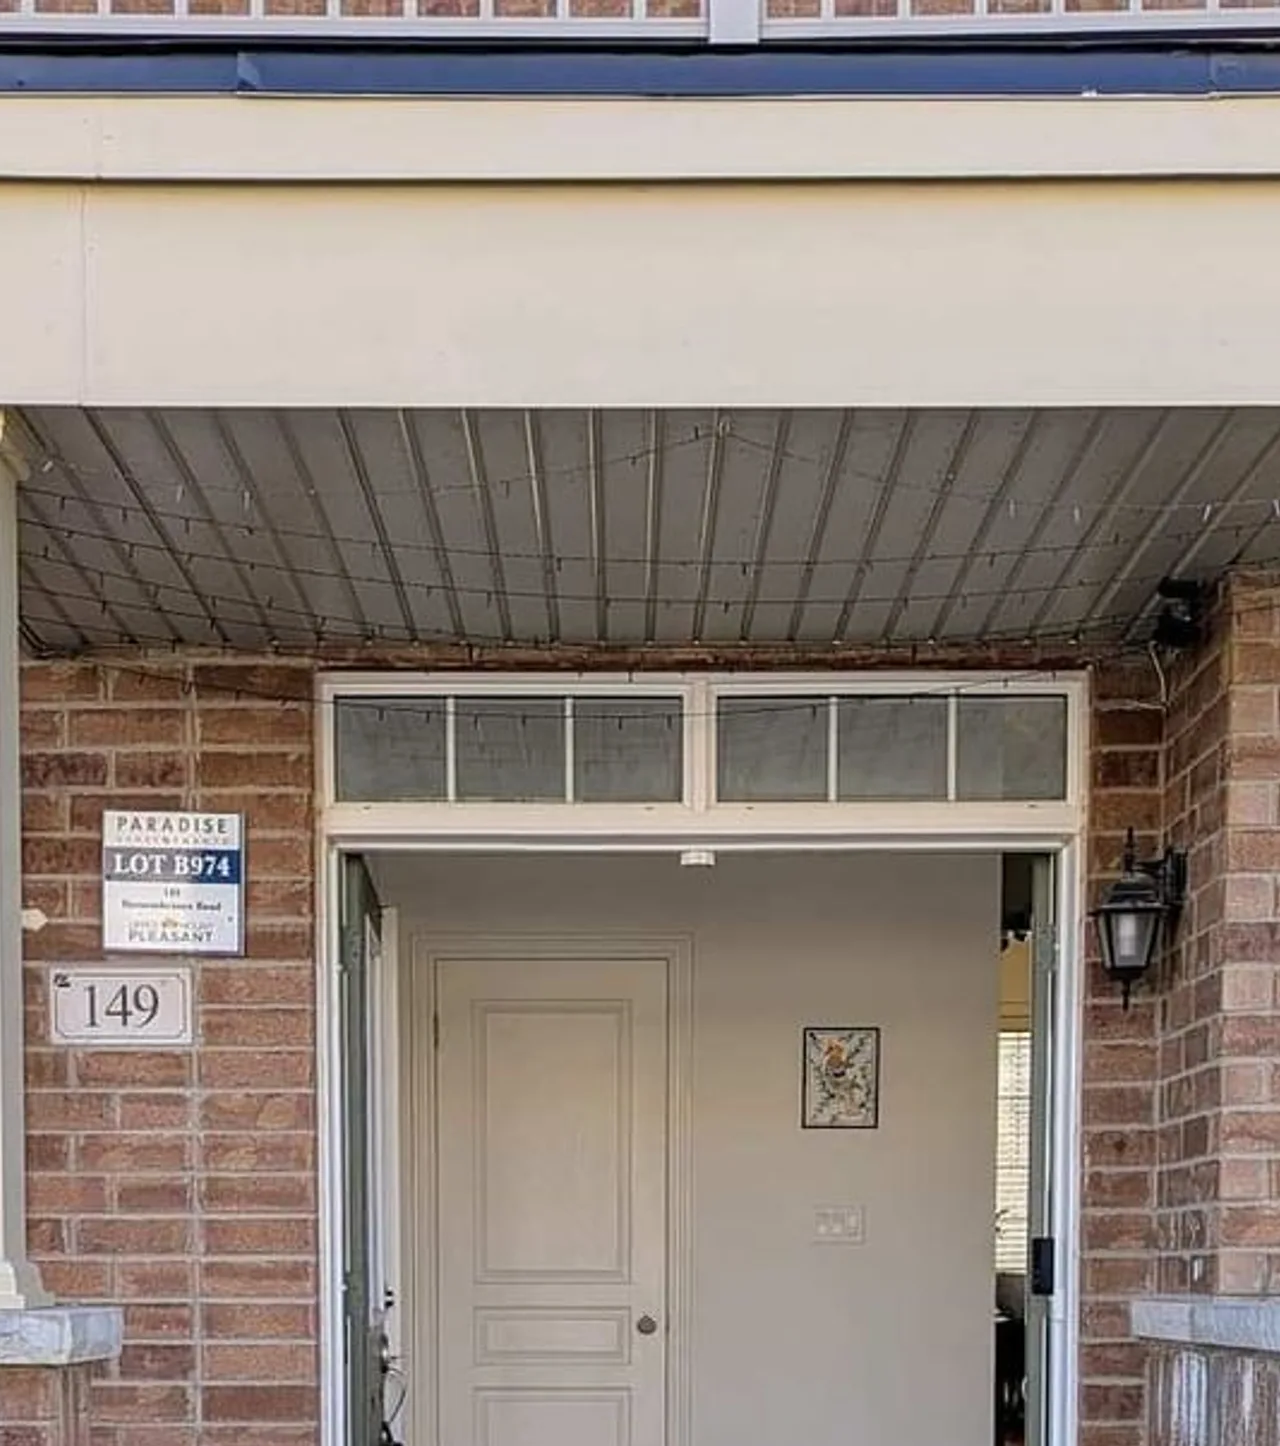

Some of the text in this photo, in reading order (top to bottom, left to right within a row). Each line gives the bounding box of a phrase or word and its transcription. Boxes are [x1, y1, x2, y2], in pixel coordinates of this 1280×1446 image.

[116, 816, 227, 834] PARADISE
[114, 852, 231, 877] LOT B974
[128, 928, 213, 942] PLEASANT
[84, 984, 159, 1028] 149
